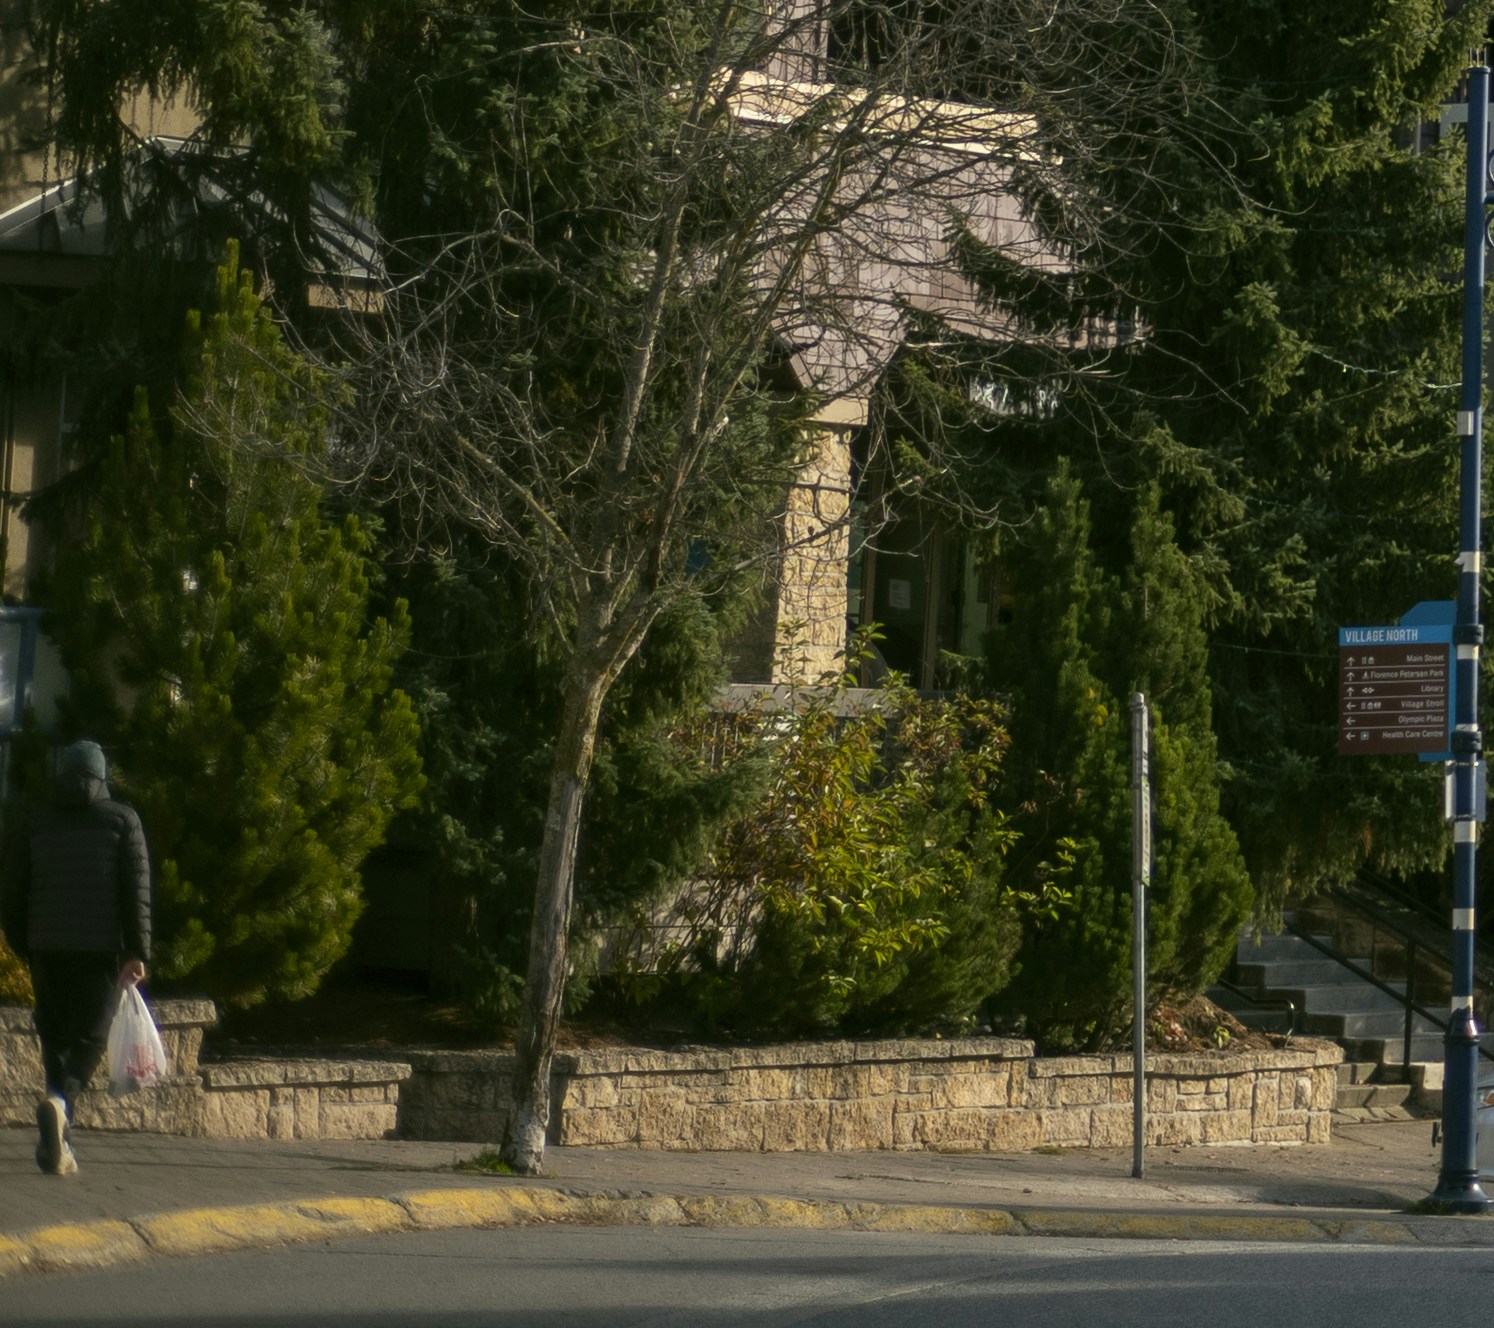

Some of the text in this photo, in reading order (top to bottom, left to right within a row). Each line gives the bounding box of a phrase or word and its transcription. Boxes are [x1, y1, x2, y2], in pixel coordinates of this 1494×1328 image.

[1345, 629, 1418, 643] VILLAGE NORTH
[1406, 654, 1444, 662] Main Street
[1370, 671, 1398, 679] Florence
[1429, 669, 1444, 677] Park
[1421, 685, 1444, 693] Library
[1401, 699, 1444, 709] Village Stroll
[1398, 714, 1444, 724] Olympic Plaza
[1382, 731, 1404, 739] Health
[1405, 730, 1420, 738] Care
